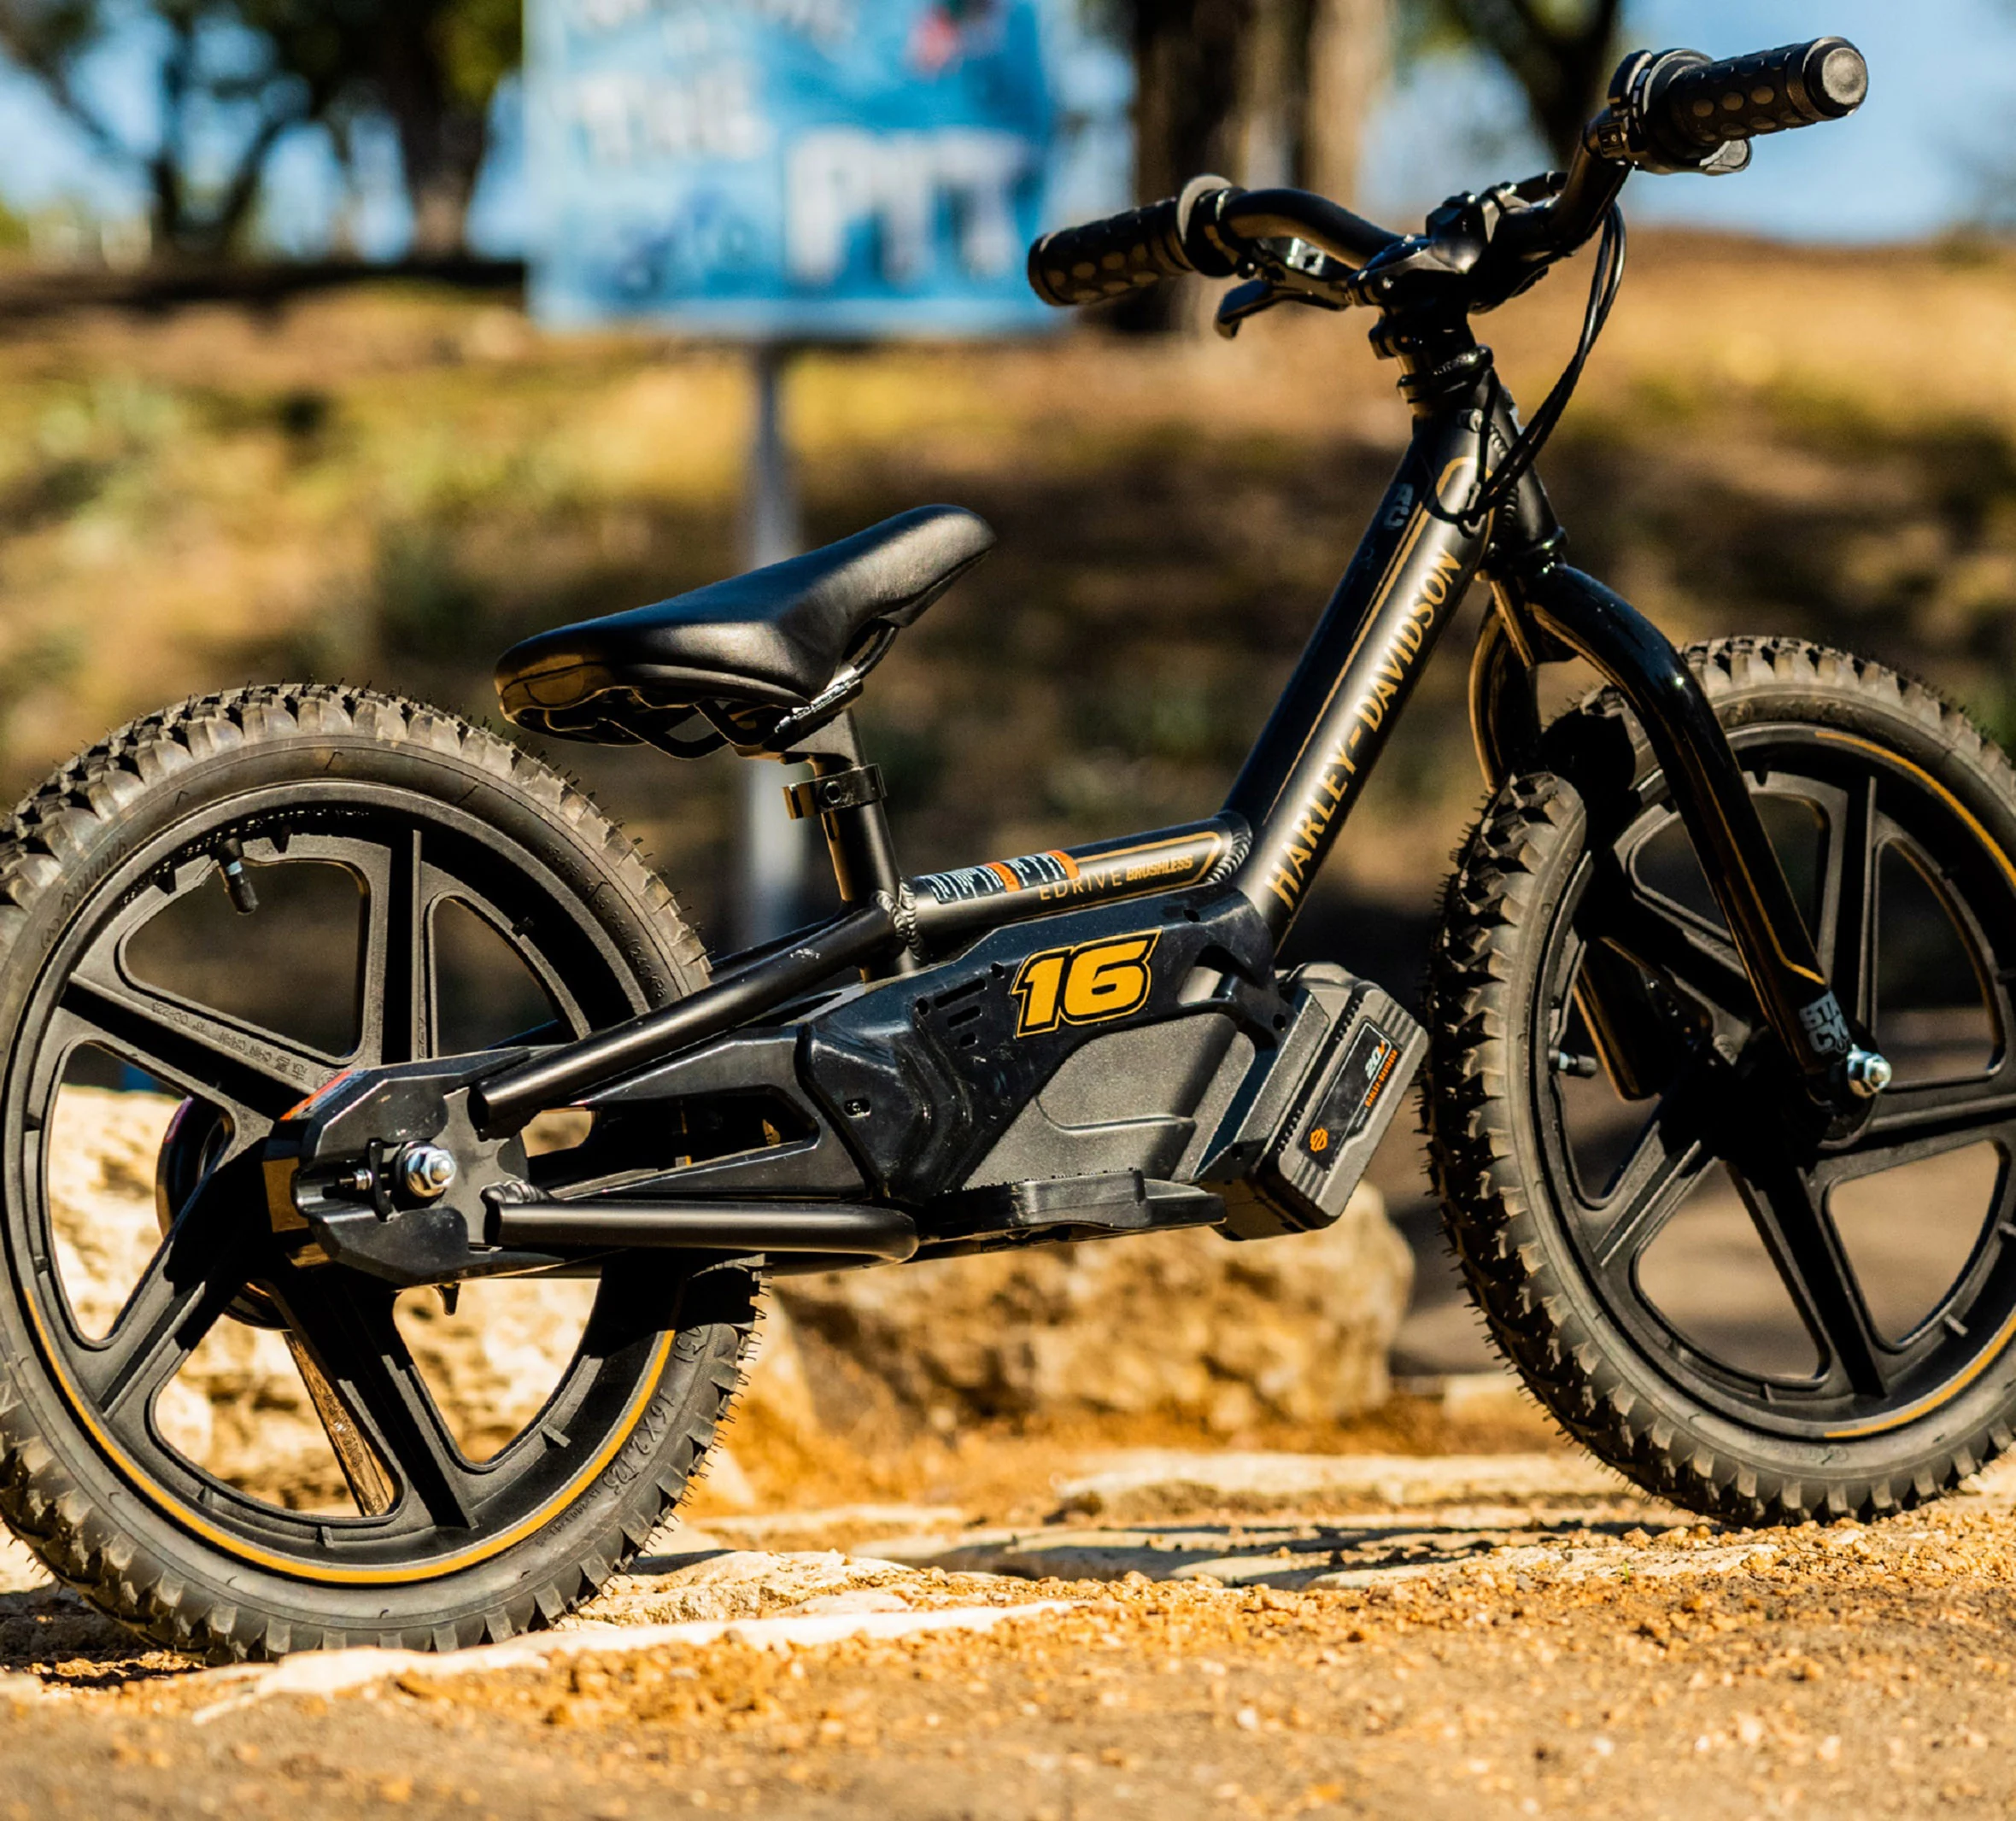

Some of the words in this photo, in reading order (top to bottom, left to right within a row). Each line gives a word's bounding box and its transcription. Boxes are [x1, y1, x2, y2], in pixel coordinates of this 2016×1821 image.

[1264, 547, 1462, 911] HARLEY-DAVIDSON
[1039, 869, 1122, 900] EDRIVE
[1126, 855, 1193, 881] BRUSHLESS
[1012, 929, 1161, 1036] 16
[602, 1387, 675, 1496] 16X2.125
